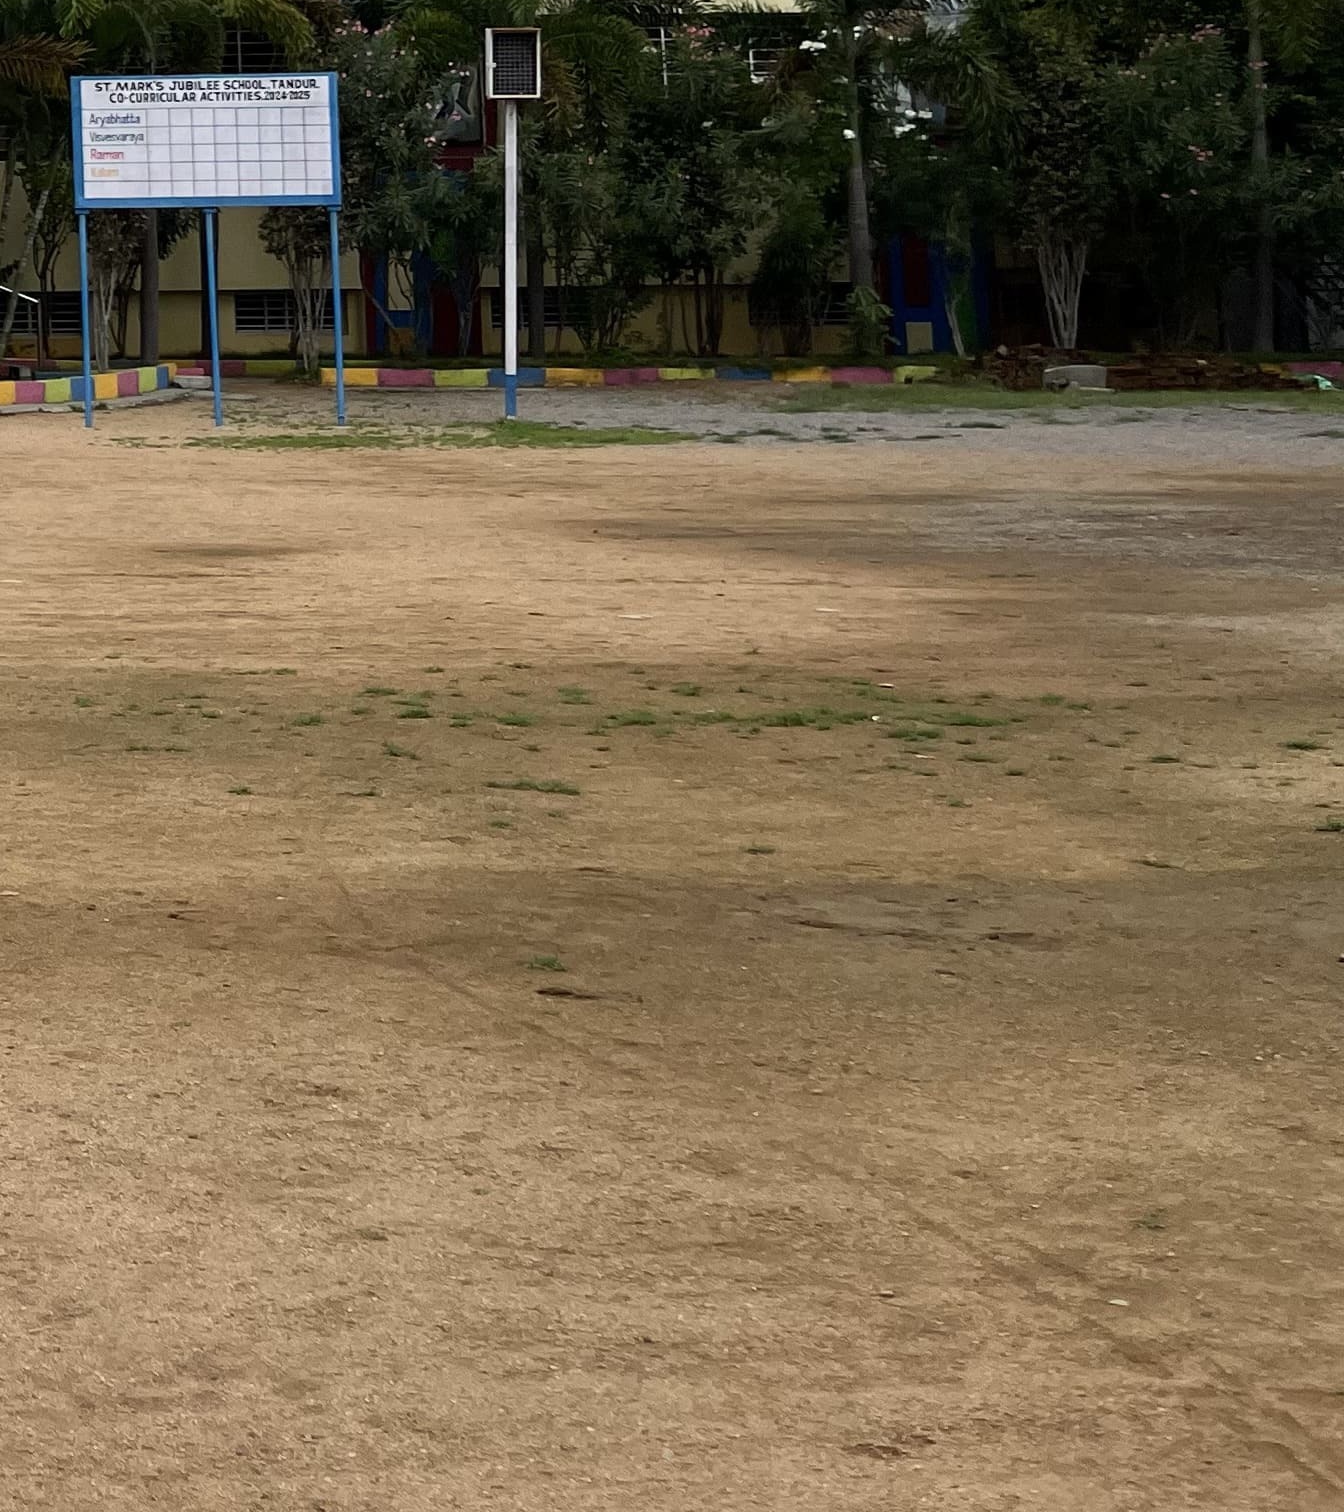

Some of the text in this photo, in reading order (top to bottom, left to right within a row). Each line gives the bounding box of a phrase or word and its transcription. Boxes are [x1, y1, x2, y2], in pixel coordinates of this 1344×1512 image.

[115, 81, 164, 91] MARK'S
[169, 80, 220, 90] JUBILEE
[109, 92, 196, 103] CO-CURRICULAR
[89, 112, 140, 127] Aryabhatta
[90, 148, 124, 160] Raman
